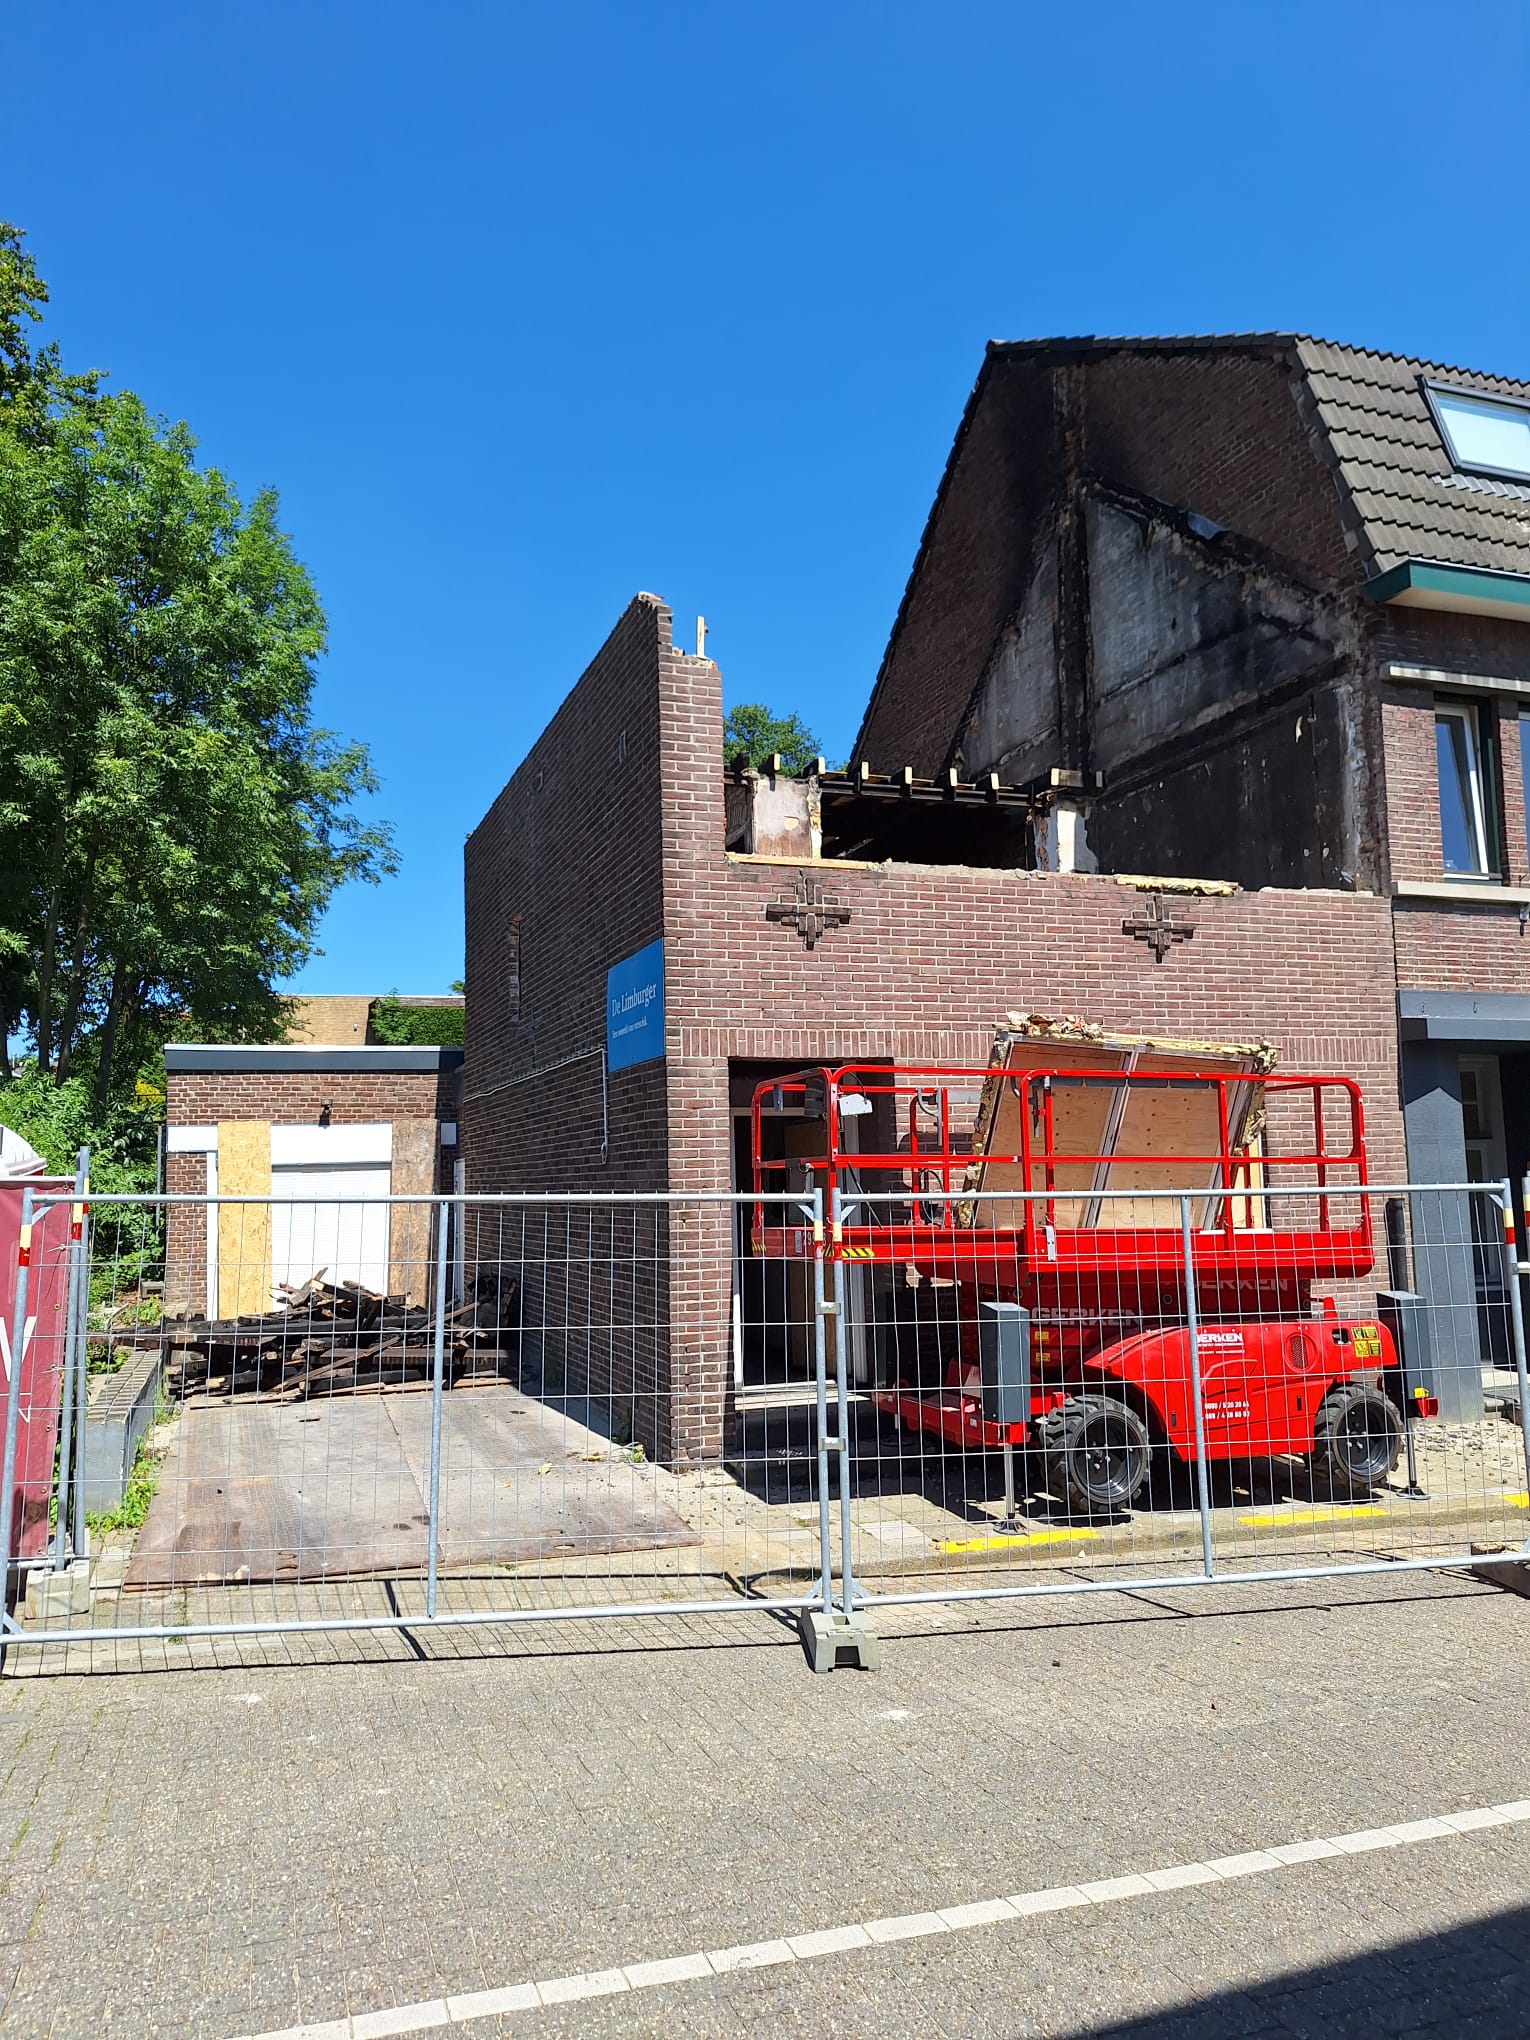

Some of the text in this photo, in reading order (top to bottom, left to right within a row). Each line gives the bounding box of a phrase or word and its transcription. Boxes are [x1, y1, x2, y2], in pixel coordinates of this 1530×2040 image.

[612, 984, 657, 1016] De Limburger
[1031, 1307, 1143, 1326] GERKEN
